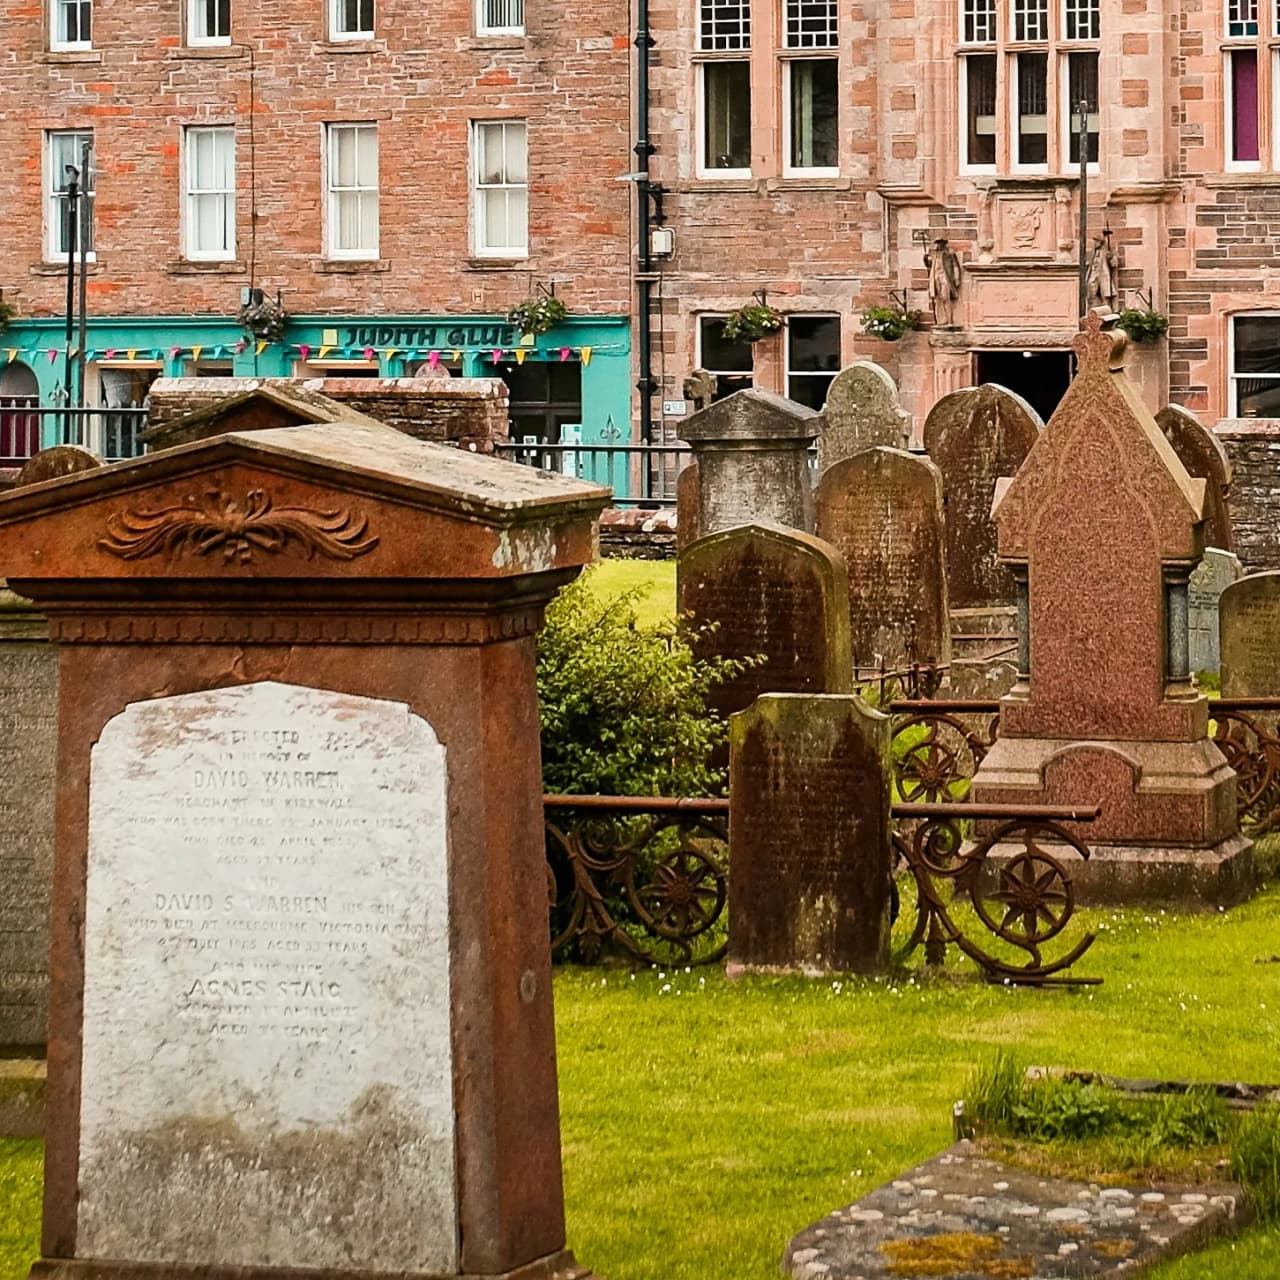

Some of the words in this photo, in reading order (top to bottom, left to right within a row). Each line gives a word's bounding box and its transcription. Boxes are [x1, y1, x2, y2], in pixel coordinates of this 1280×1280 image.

[345, 327, 436, 347] JUDITH
[447, 327, 514, 346] GLUE
[231, 730, 300, 744] ERECTED
[194, 770, 249, 789] DAVID
[155, 892, 214, 913] DAVID
[187, 978, 267, 999] AGNES
